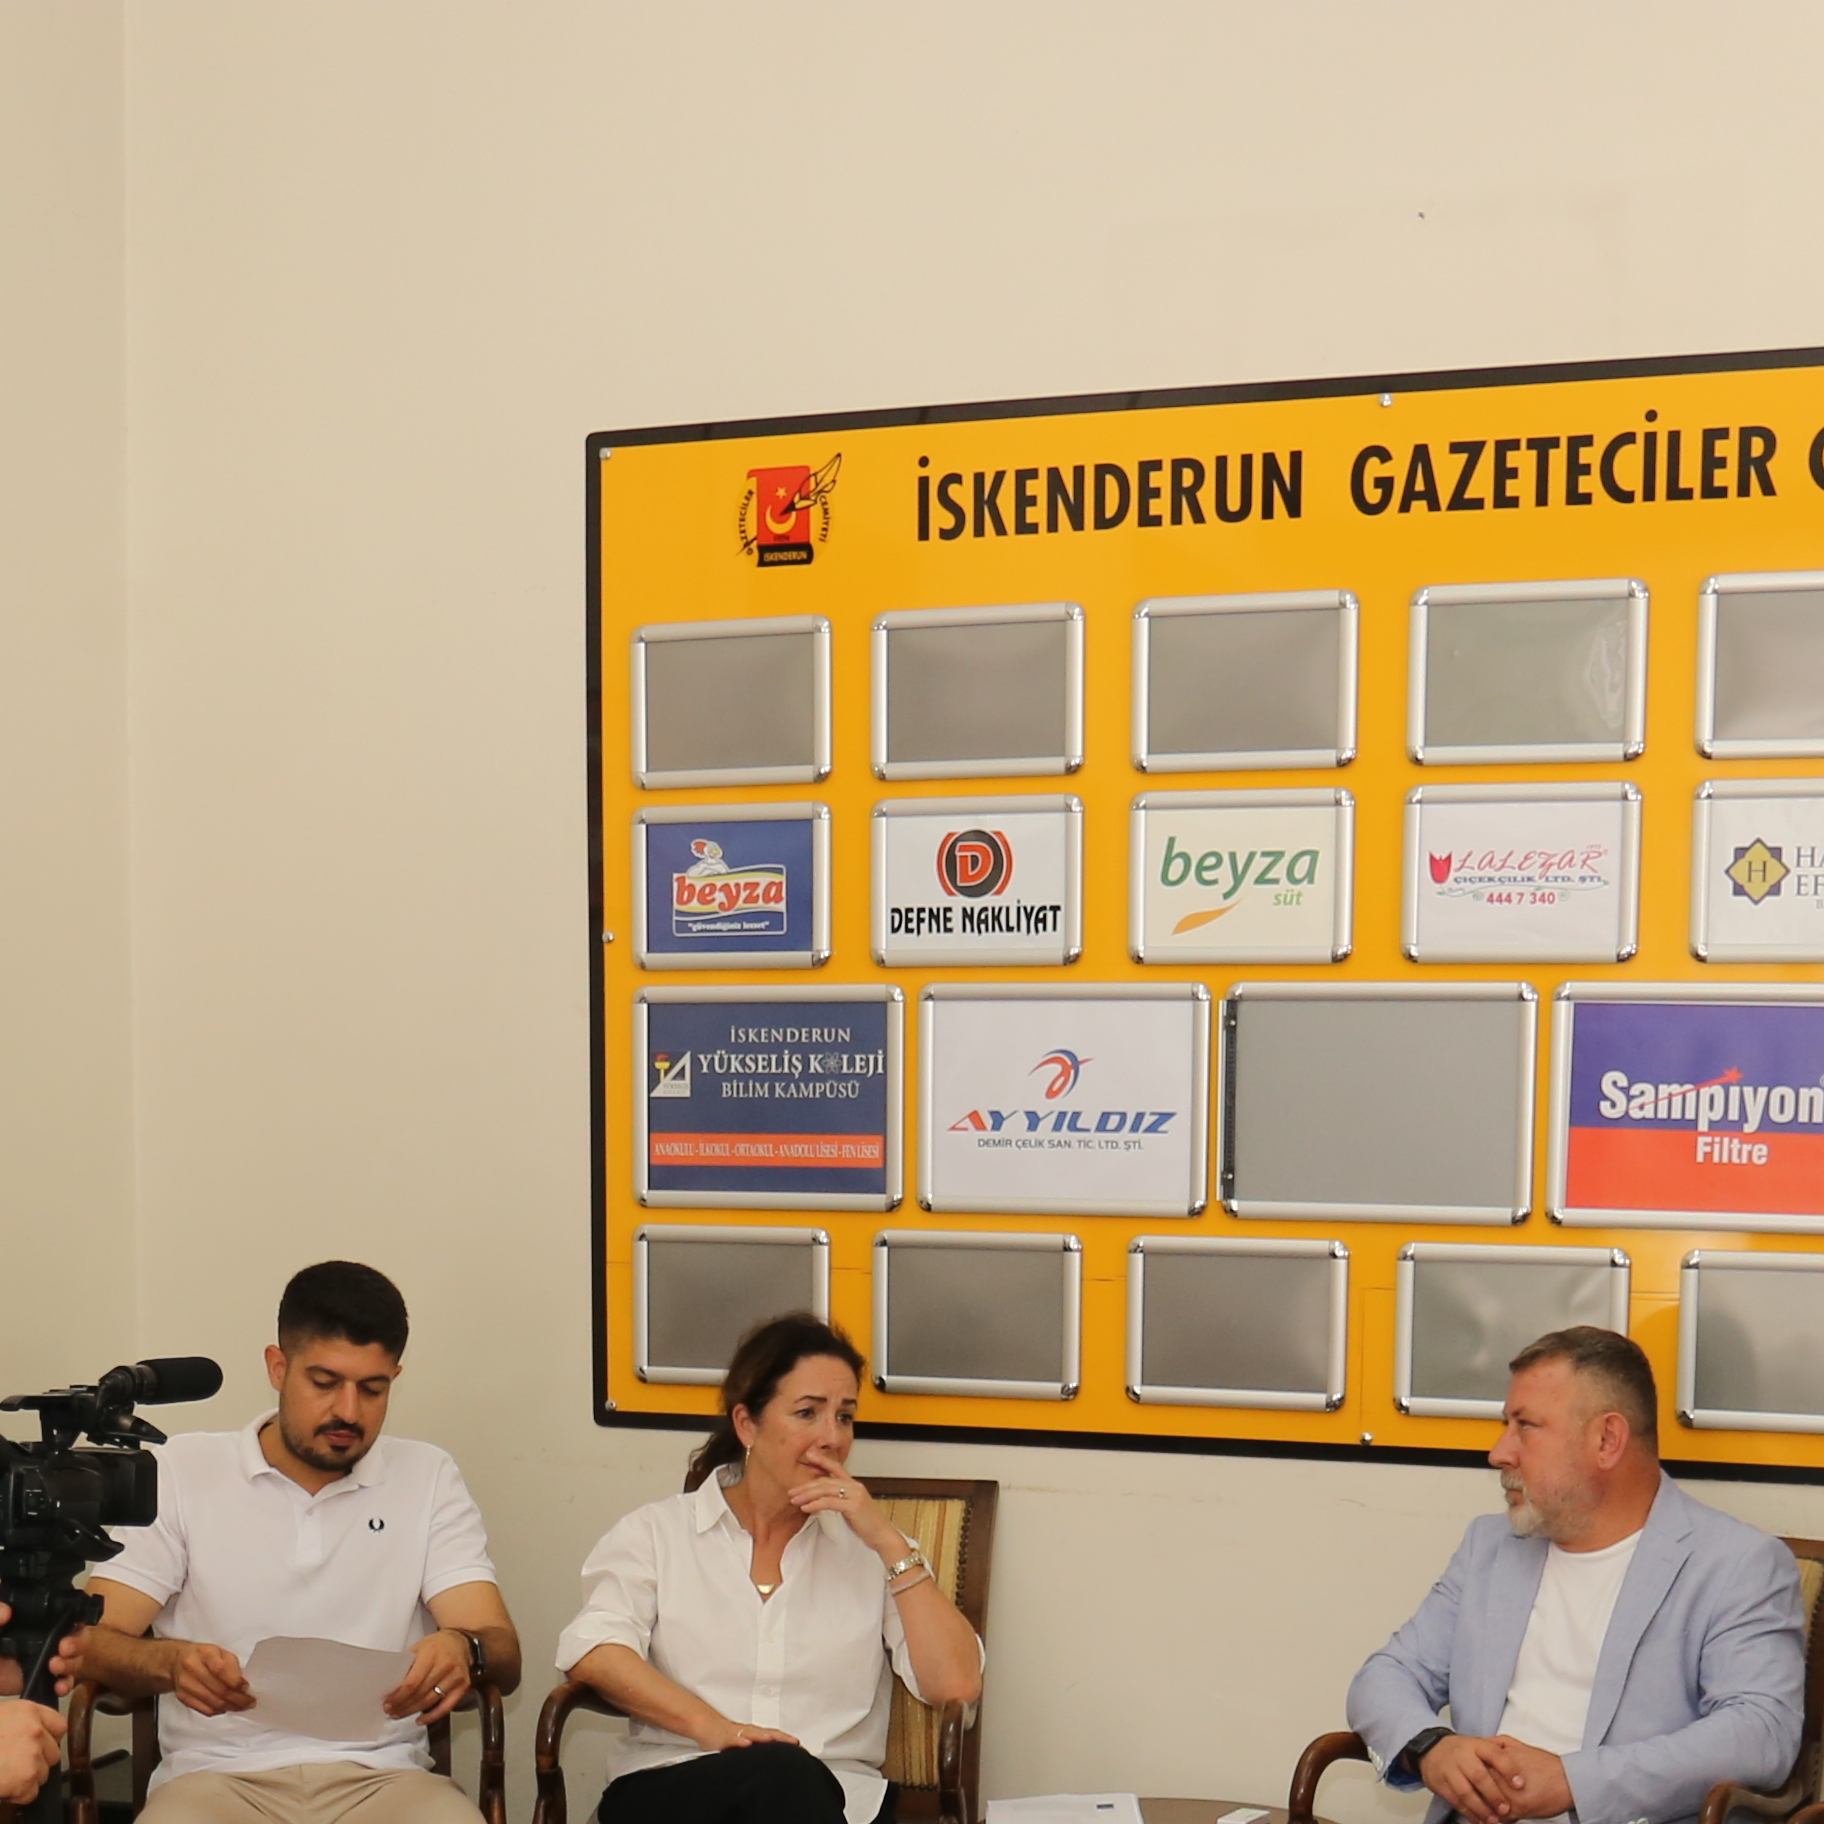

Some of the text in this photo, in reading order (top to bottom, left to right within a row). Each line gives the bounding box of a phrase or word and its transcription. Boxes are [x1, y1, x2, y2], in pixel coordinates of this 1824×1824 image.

[917, 451, 1303, 541] İSKENDERUN
[1350, 410, 1776, 515] GAZETECİLER
[1160, 836, 1320, 899] beyza
[1453, 849, 1603, 880] LALEZAR
[1747, 860, 1767, 883] H
[675, 875, 785, 912] beyza
[1273, 889, 1303, 906] süt
[1486, 892, 1556, 905] 444 7 340
[890, 899, 1062, 937] DEFNE NAKLİYAT
[730, 1025, 851, 1043] İSKENDERUN
[697, 1050, 802, 1079] YÜKSELİŞ
[721, 1079, 860, 1098] BİLİM KAMPÜSÜ
[948, 1109, 1177, 1134] AYYILDIZ
[977, 1137, 1013, 1149] DEMİR
[1015, 1137, 1045, 1151] ÇELİK
[1047, 1139, 1075, 1150] SAN.
[1098, 1139, 1121, 1150] LTD.
[1696, 1135, 1768, 1165] Filtre
